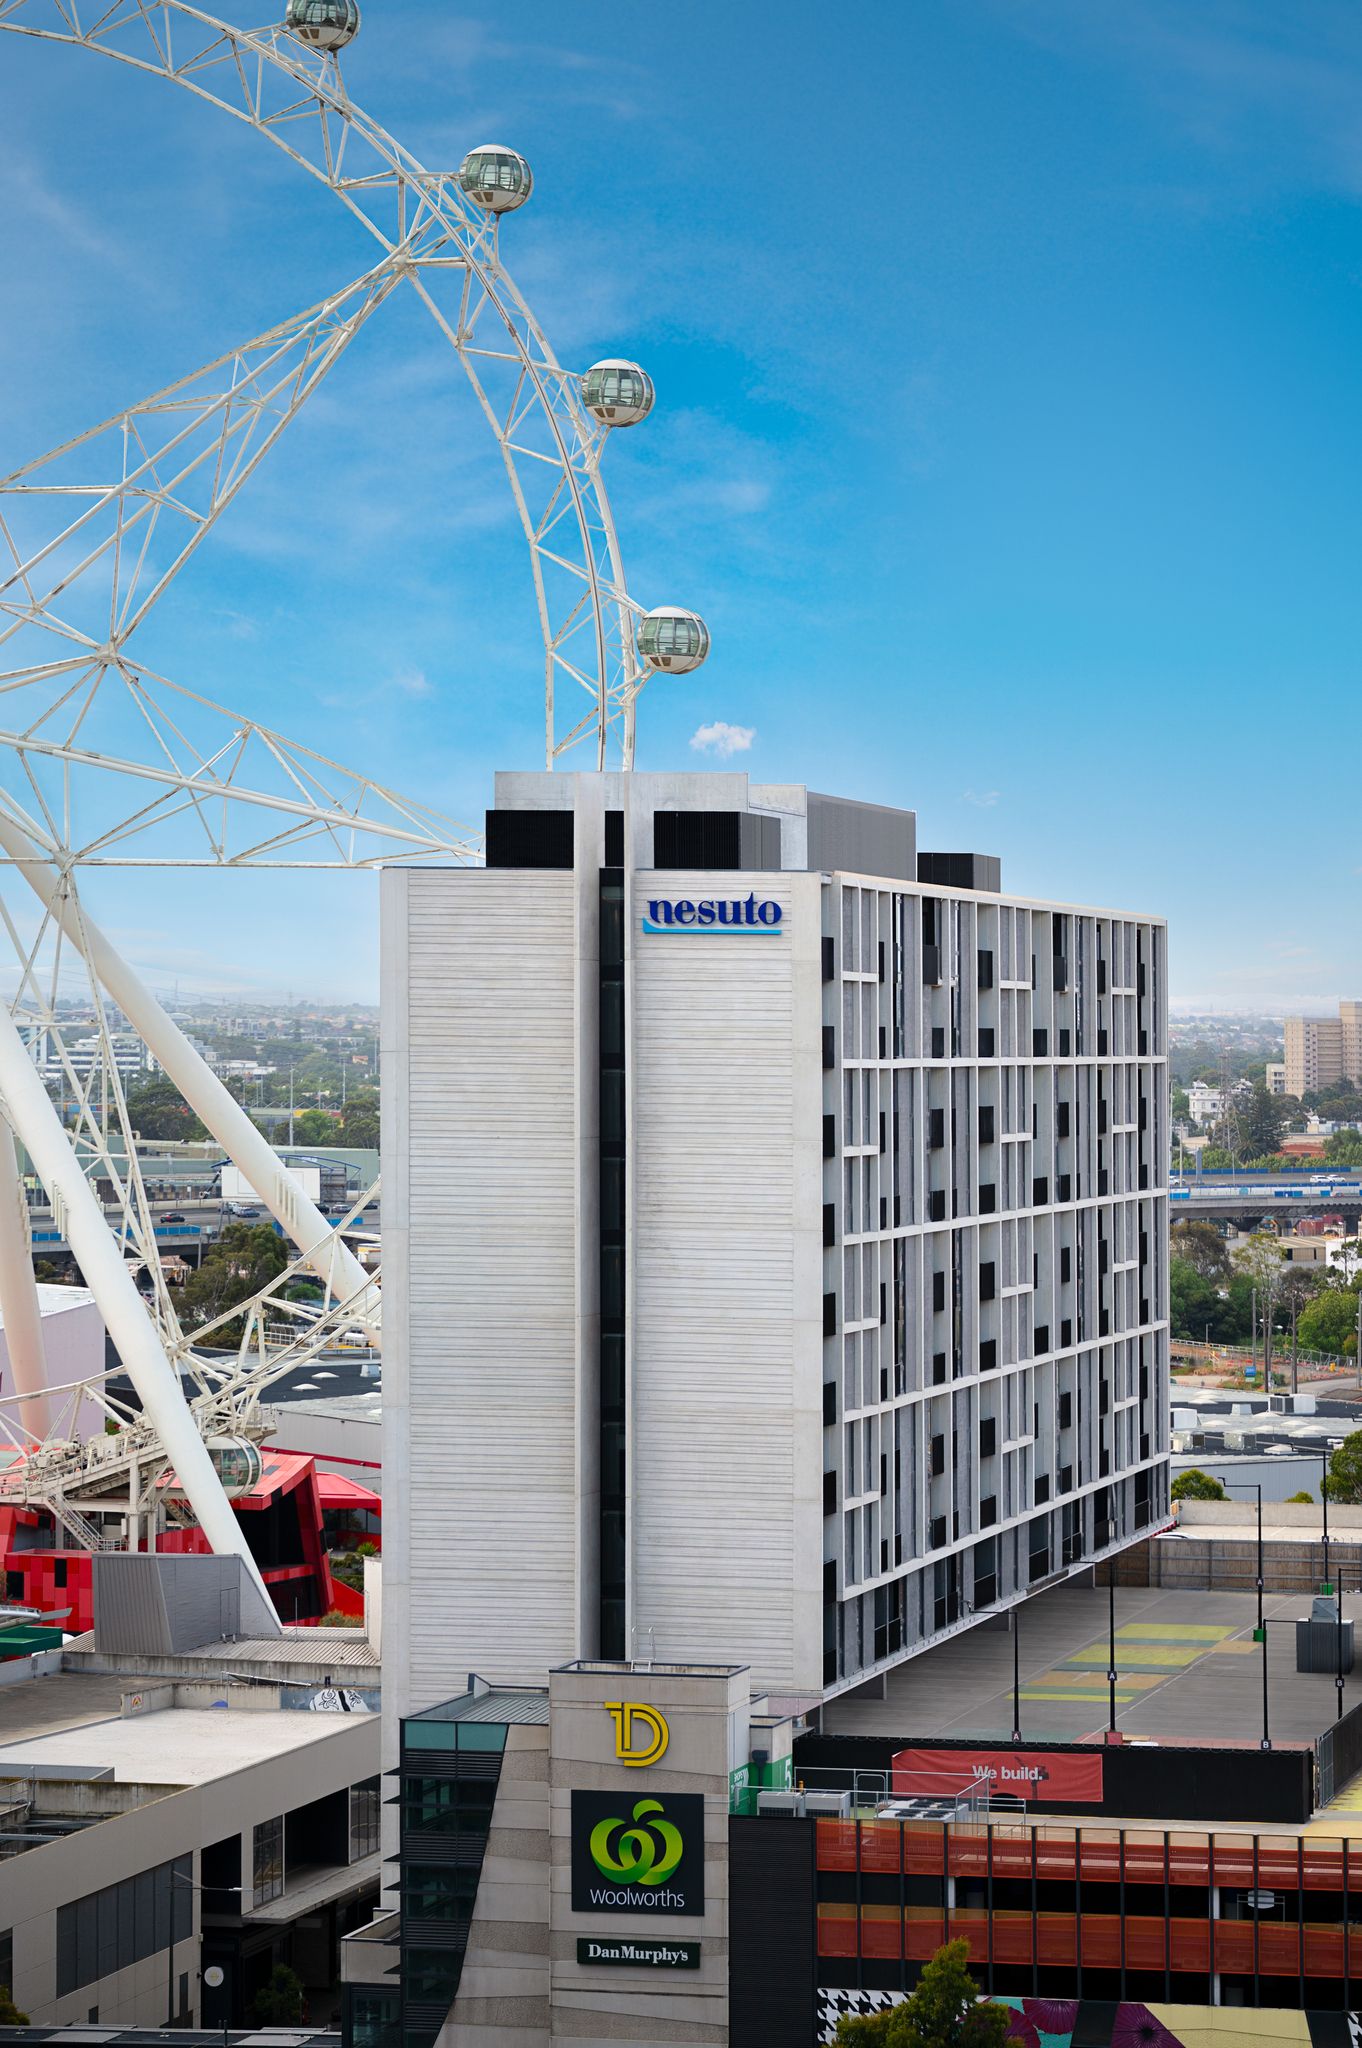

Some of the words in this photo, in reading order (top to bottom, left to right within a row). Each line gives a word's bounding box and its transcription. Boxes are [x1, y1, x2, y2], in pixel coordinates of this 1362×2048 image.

[647, 891, 782, 925] nesuto
[972, 1765, 998, 1780] We
[1001, 1766, 1043, 1781] build.
[590, 1887, 685, 1908] Woolworths
